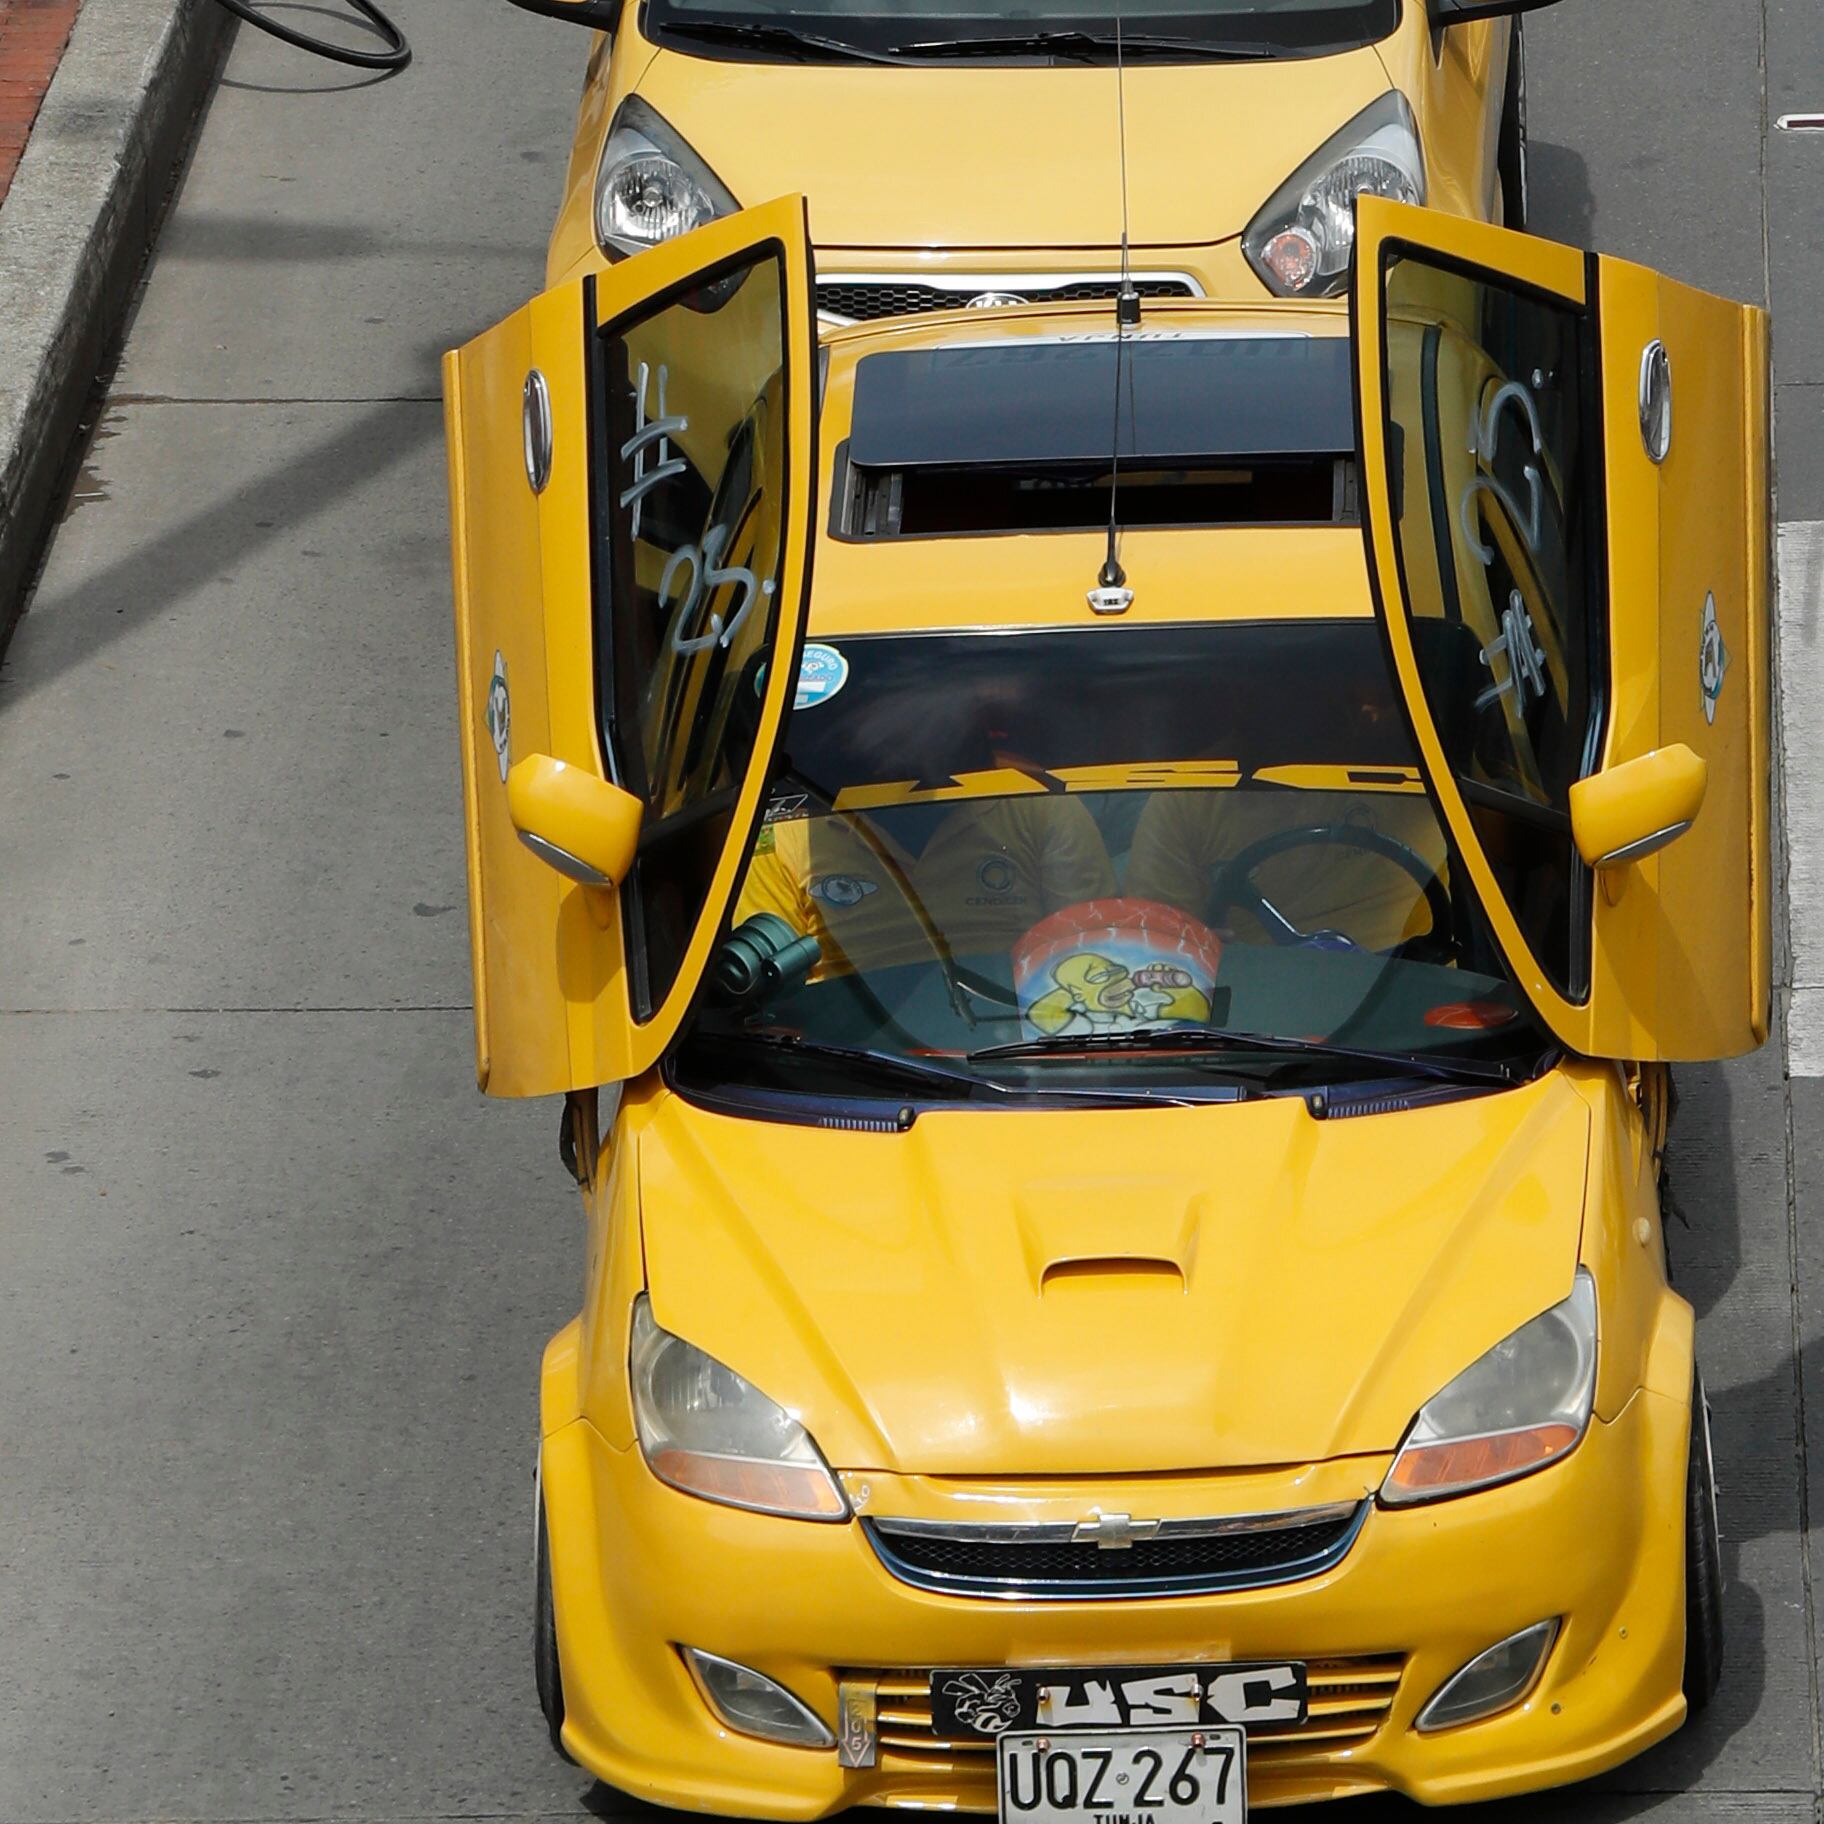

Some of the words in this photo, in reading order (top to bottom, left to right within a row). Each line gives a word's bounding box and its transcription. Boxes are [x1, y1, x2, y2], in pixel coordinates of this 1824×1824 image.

[1035, 1666, 1301, 1727] USC
[1009, 1750, 1114, 1811] UQZ
[1132, 1749, 1237, 1807] 267
